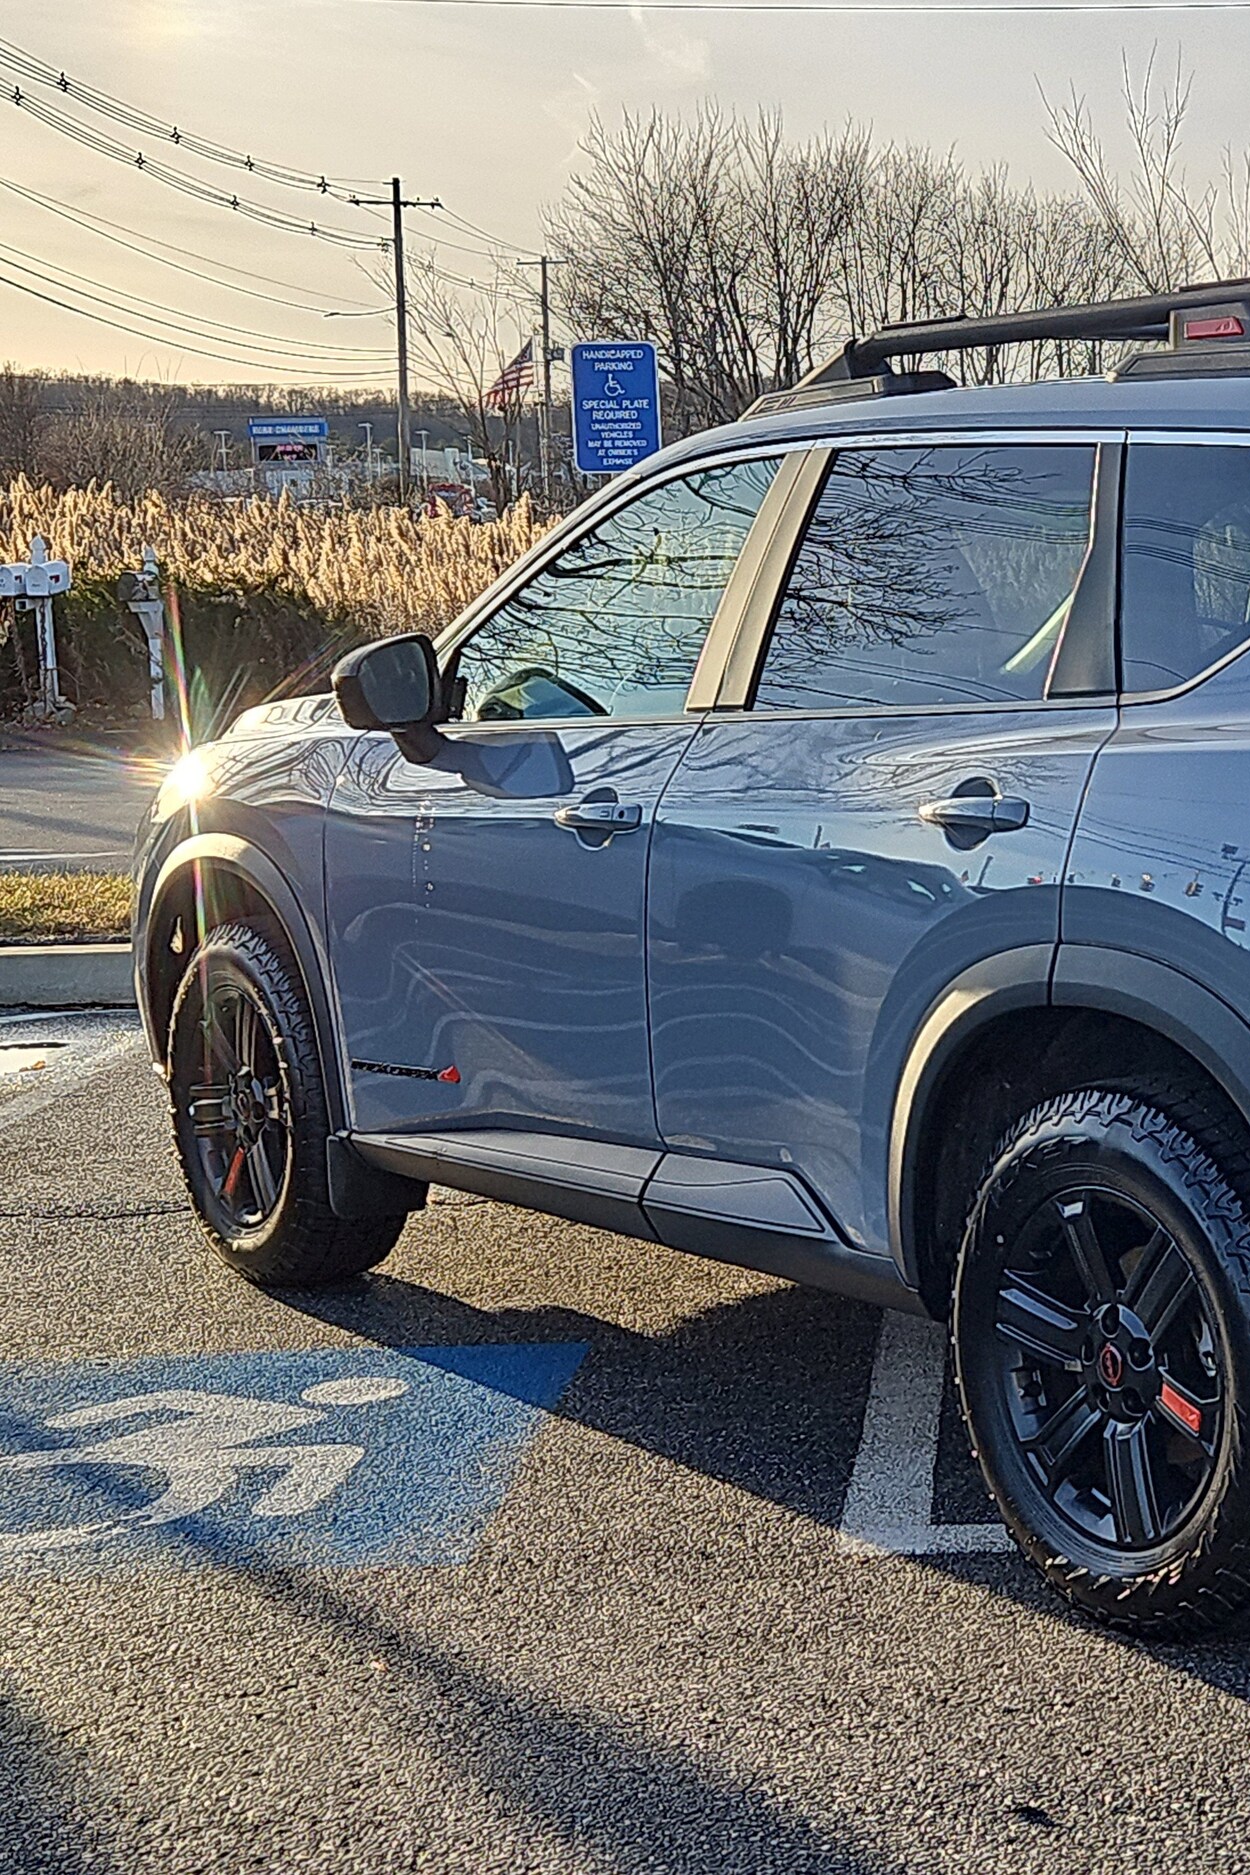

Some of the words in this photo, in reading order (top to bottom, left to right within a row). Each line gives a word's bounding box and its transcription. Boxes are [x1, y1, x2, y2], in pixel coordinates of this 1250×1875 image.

[582, 349, 644, 360] HANDICAPPED
[594, 361, 634, 371] PARKING
[582, 400, 620, 410] SPECIAL
[622, 399, 650, 409] PLATE
[592, 410, 638, 420] REQUIRED
[591, 422, 642, 430] UNAUTHORIZED
[600, 430, 634, 439] VEHICLES
[587, 440, 601, 448] MAY
[614, 440, 647, 448] REMOVED
[597, 449, 606, 457] AT
